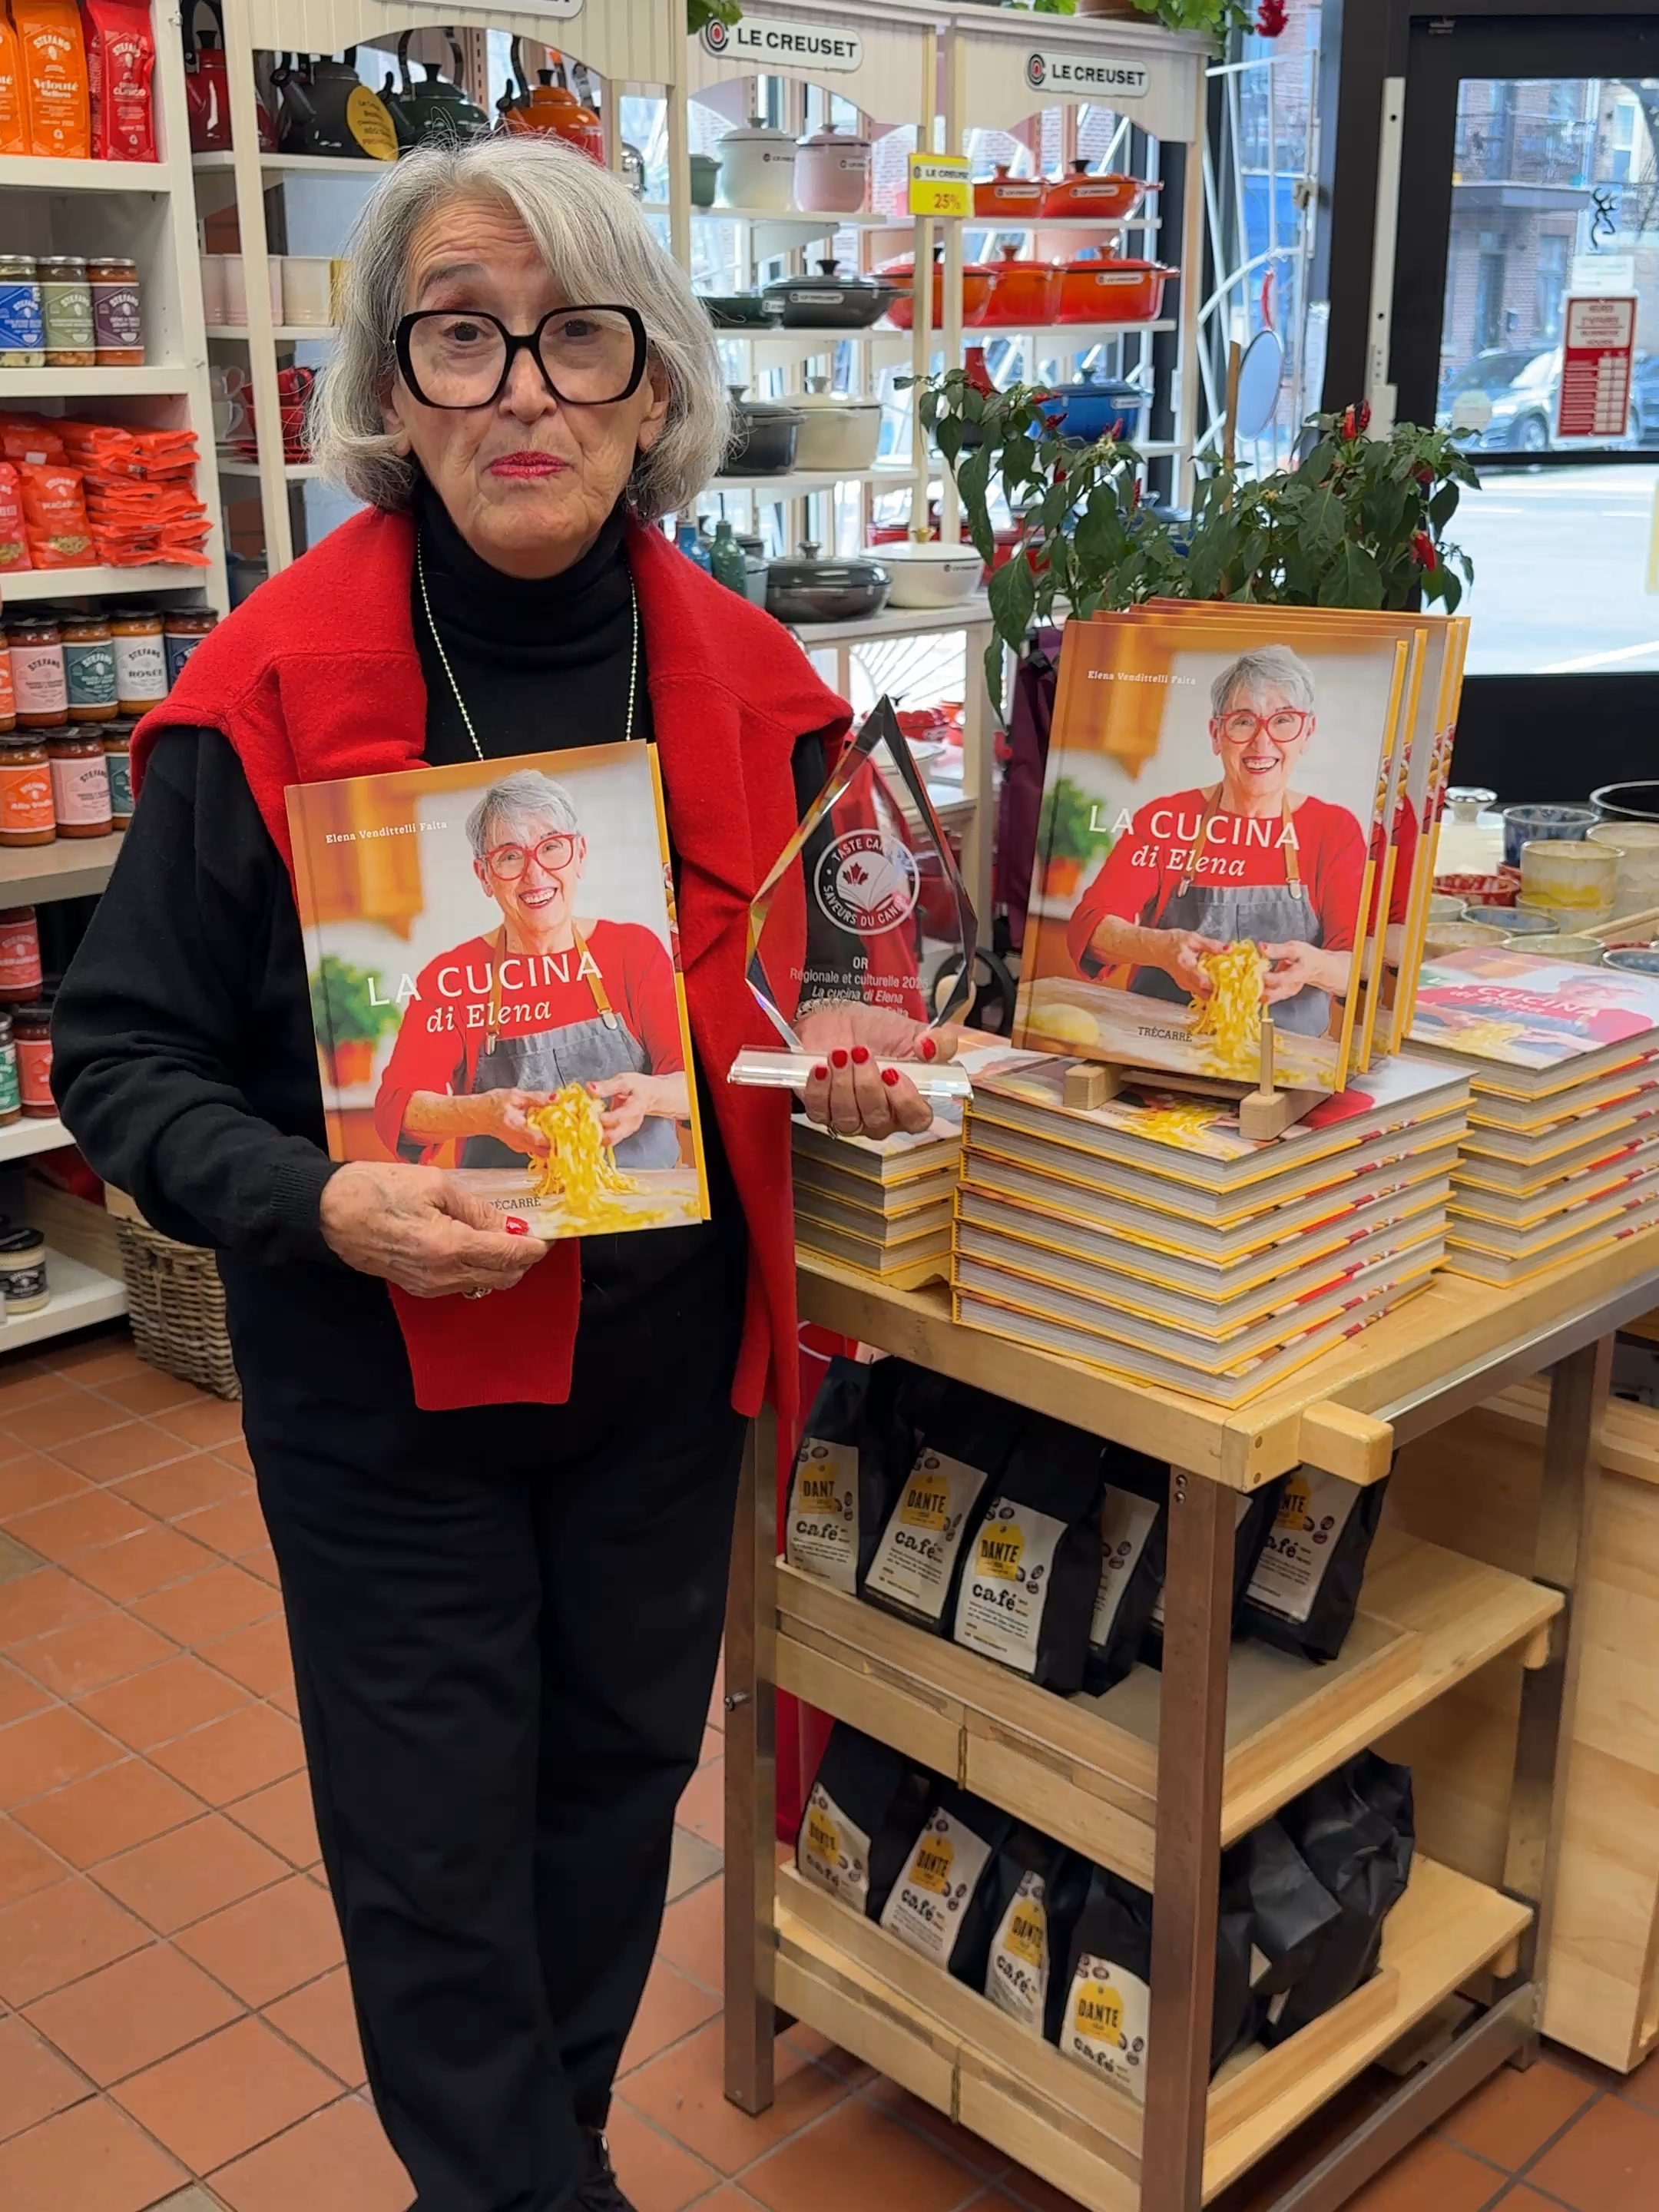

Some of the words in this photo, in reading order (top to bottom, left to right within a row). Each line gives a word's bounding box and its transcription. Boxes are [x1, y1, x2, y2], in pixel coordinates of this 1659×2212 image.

[737, 28, 763, 47] LE
[766, 31, 859, 59] CREUSET
[1051, 64, 1071, 79] LE
[1075, 67, 1146, 87] CREUSET
[1087, 670, 1114, 680] Elena
[325, 833, 356, 844] Elena
[359, 823, 417, 839] Vendittelli
[1088, 805, 1134, 836] LA
[1151, 810, 1300, 851] CUCINA
[831, 838, 863, 863] TASTE
[1131, 844, 1161, 868] di
[1165, 848, 1246, 876] Elena
[823, 884, 859, 926] SAVEURS
[860, 916, 875, 928] DU
[853, 956, 869, 970] OR
[367, 972, 422, 1007] LA
[436, 950, 604, 998] CUCINA
[841, 969, 853, 985] et
[853, 971, 900, 988] culturelle
[811, 985, 824, 998] La
[826, 987, 861, 1001] cucina
[863, 989, 874, 1002] di
[874, 990, 904, 1005] Elena
[1476, 986, 1601, 1018] CUCINA
[426, 1005, 455, 1033] di
[465, 1000, 552, 1030] Elena
[803, 1480, 836, 1497] DANT
[906, 1489, 947, 1513] DANTE
[795, 1520, 839, 1541] café
[894, 1530, 939, 1560] café
[981, 1538, 1020, 1563] DANTE
[1267, 1536, 1298, 1558] afé
[972, 1582, 1017, 1611] café
[917, 1849, 949, 1879] DANTE
[901, 1889, 936, 1922] café
[996, 1955, 1032, 1994] café
[1078, 1998, 1119, 2028] DANTE
[1074, 2036, 1115, 2073] café
